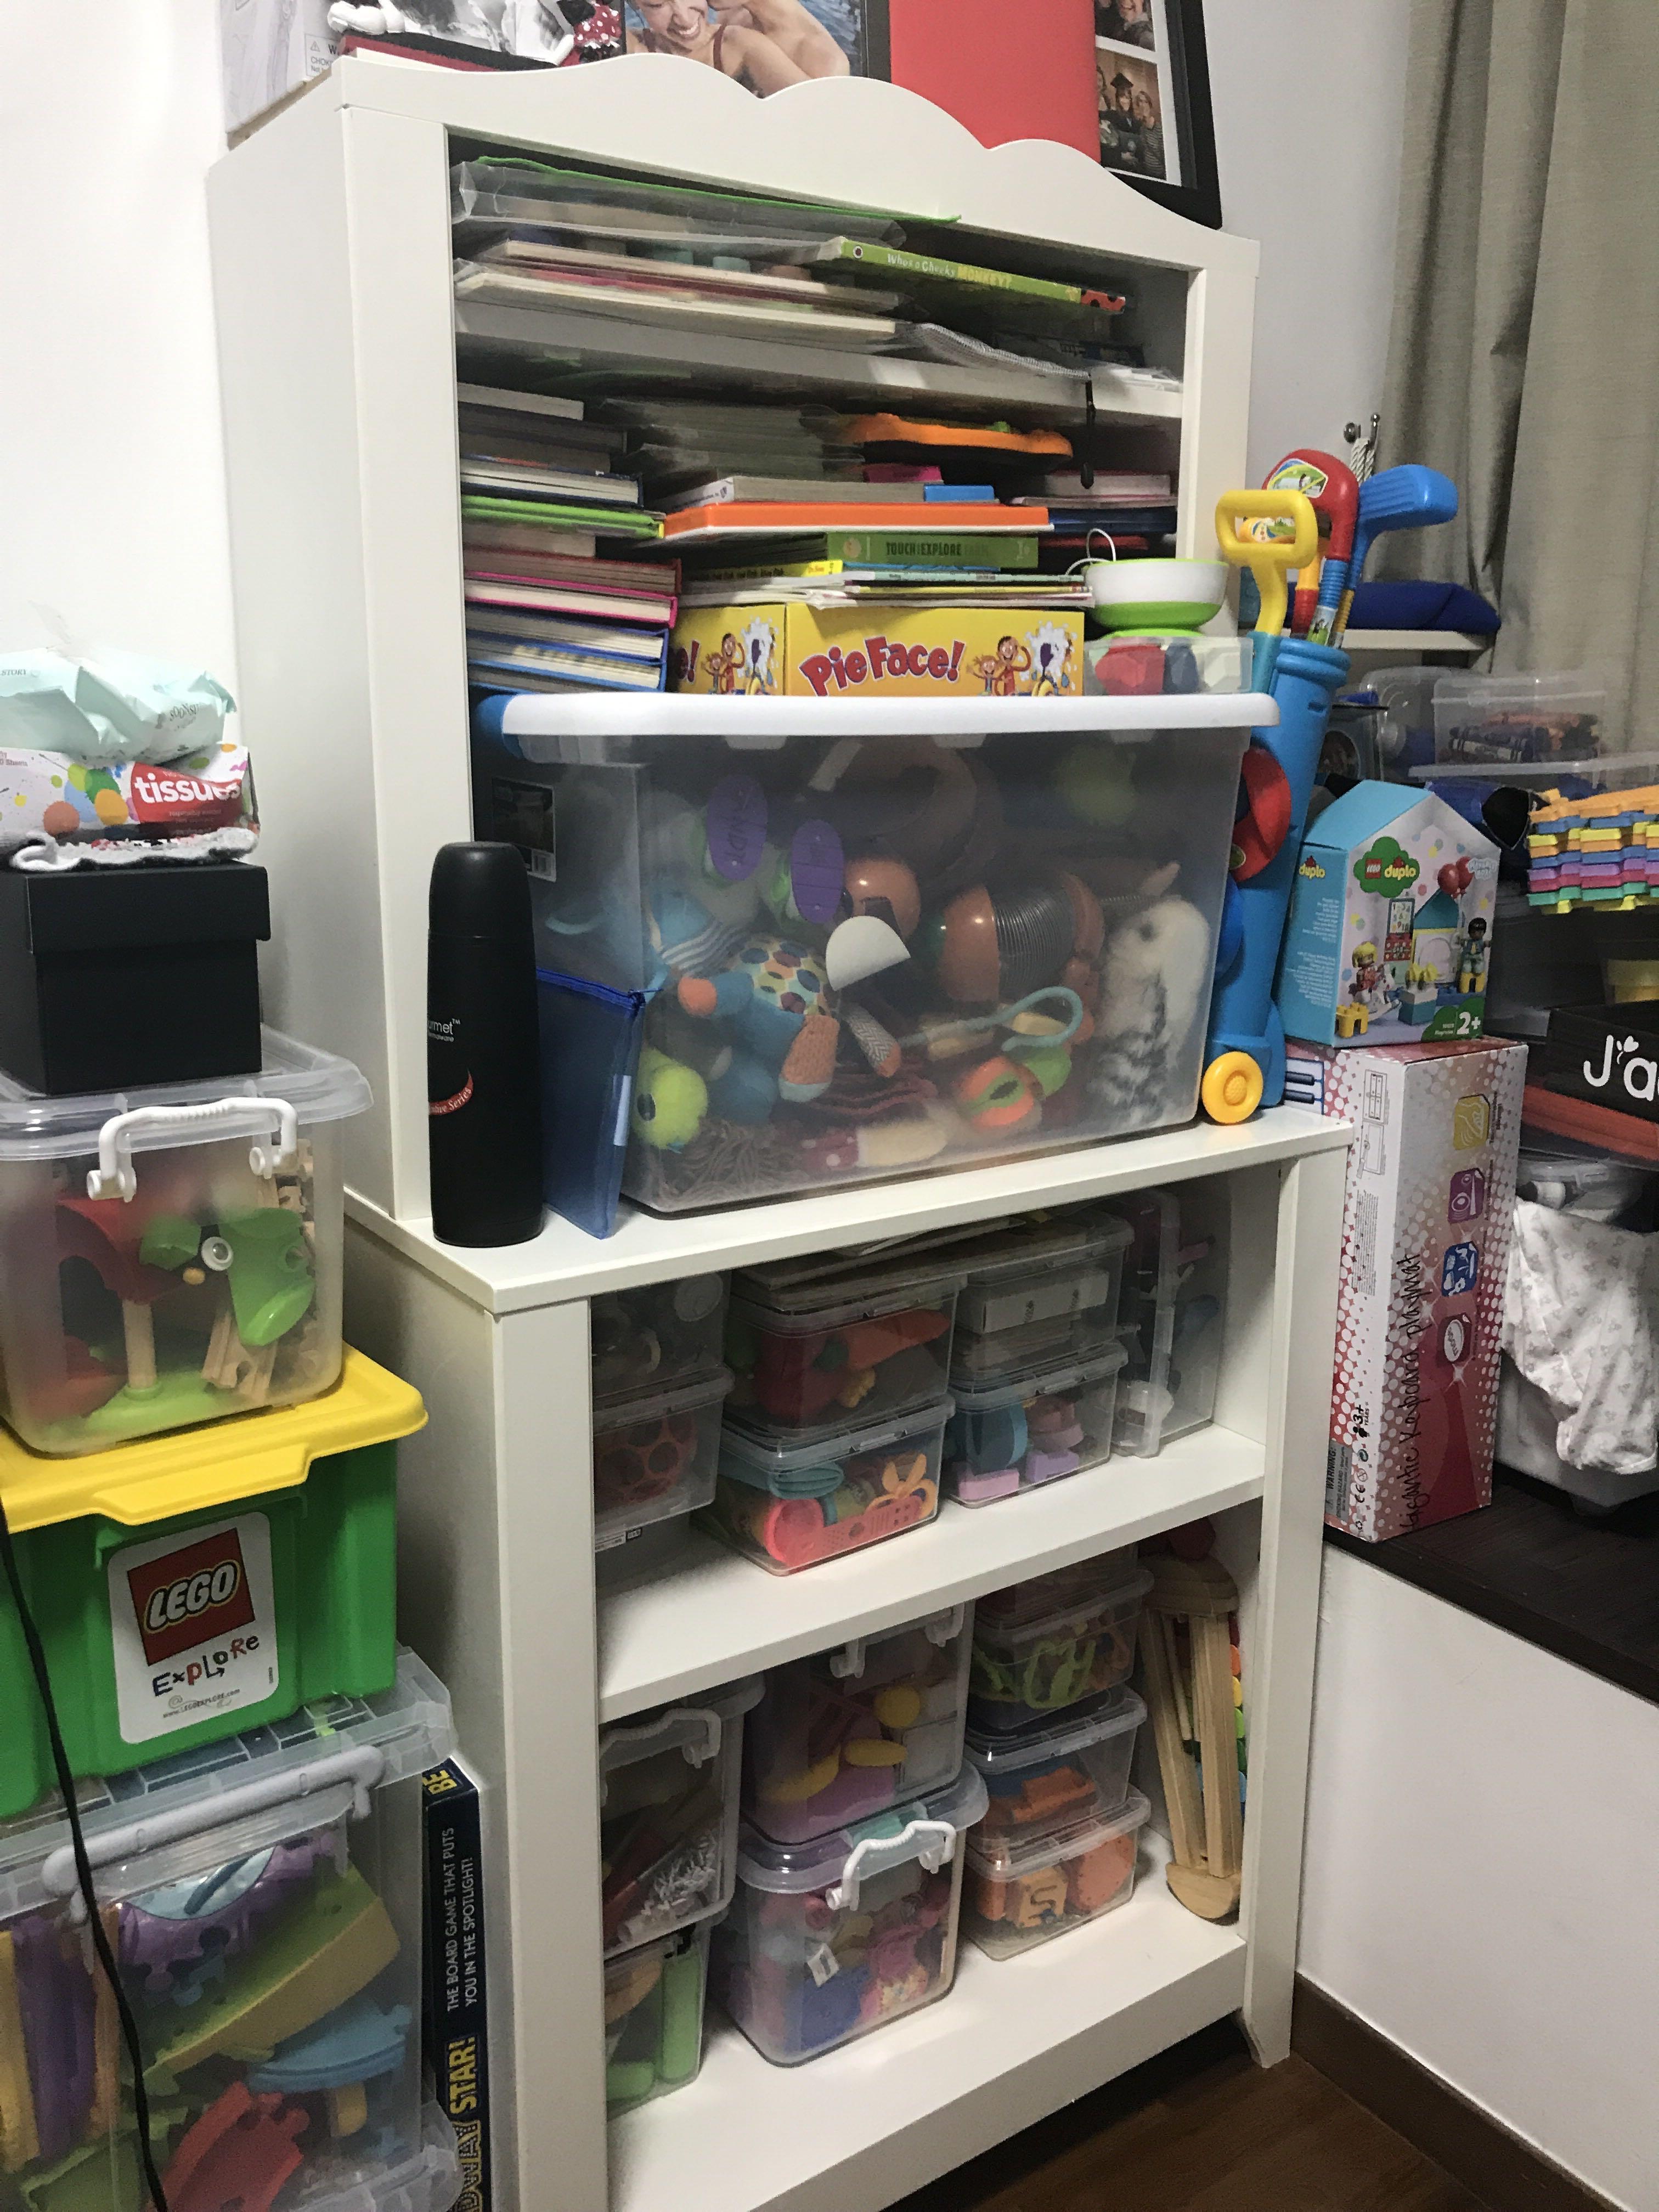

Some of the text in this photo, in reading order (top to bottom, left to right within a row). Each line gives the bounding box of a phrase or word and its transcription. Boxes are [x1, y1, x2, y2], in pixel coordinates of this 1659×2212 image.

[328, 44, 338, 54] W
[886, 541, 916, 556] TOUCH
[799, 635, 966, 697] Pie Face!
[134, 772, 241, 804] tissues
[1299, 863, 1326, 880] duplo
[1384, 863, 1417, 881] duplo
[1457, 1011, 1481, 1035] 2+
[448, 1087, 472, 1111] Series
[1397, 1254, 1432, 1340] playmat
[1353, 1404, 1364, 1425] 3+
[1326, 1447, 1337, 1490] WARNING:
[1397, 1447, 1430, 1529] Gigantic
[146, 1562, 238, 1632] LEGO
[163, 1689, 240, 1718] www.LEGOEXPLORE.com
[422, 1769, 458, 1795] BE
[442, 1827, 459, 2012] THE BOARD GAME THAT PUTS
[461, 1857, 478, 2007] YOU IN THE SPOTLIGHT!
[448, 2036, 478, 2115] STAR!
